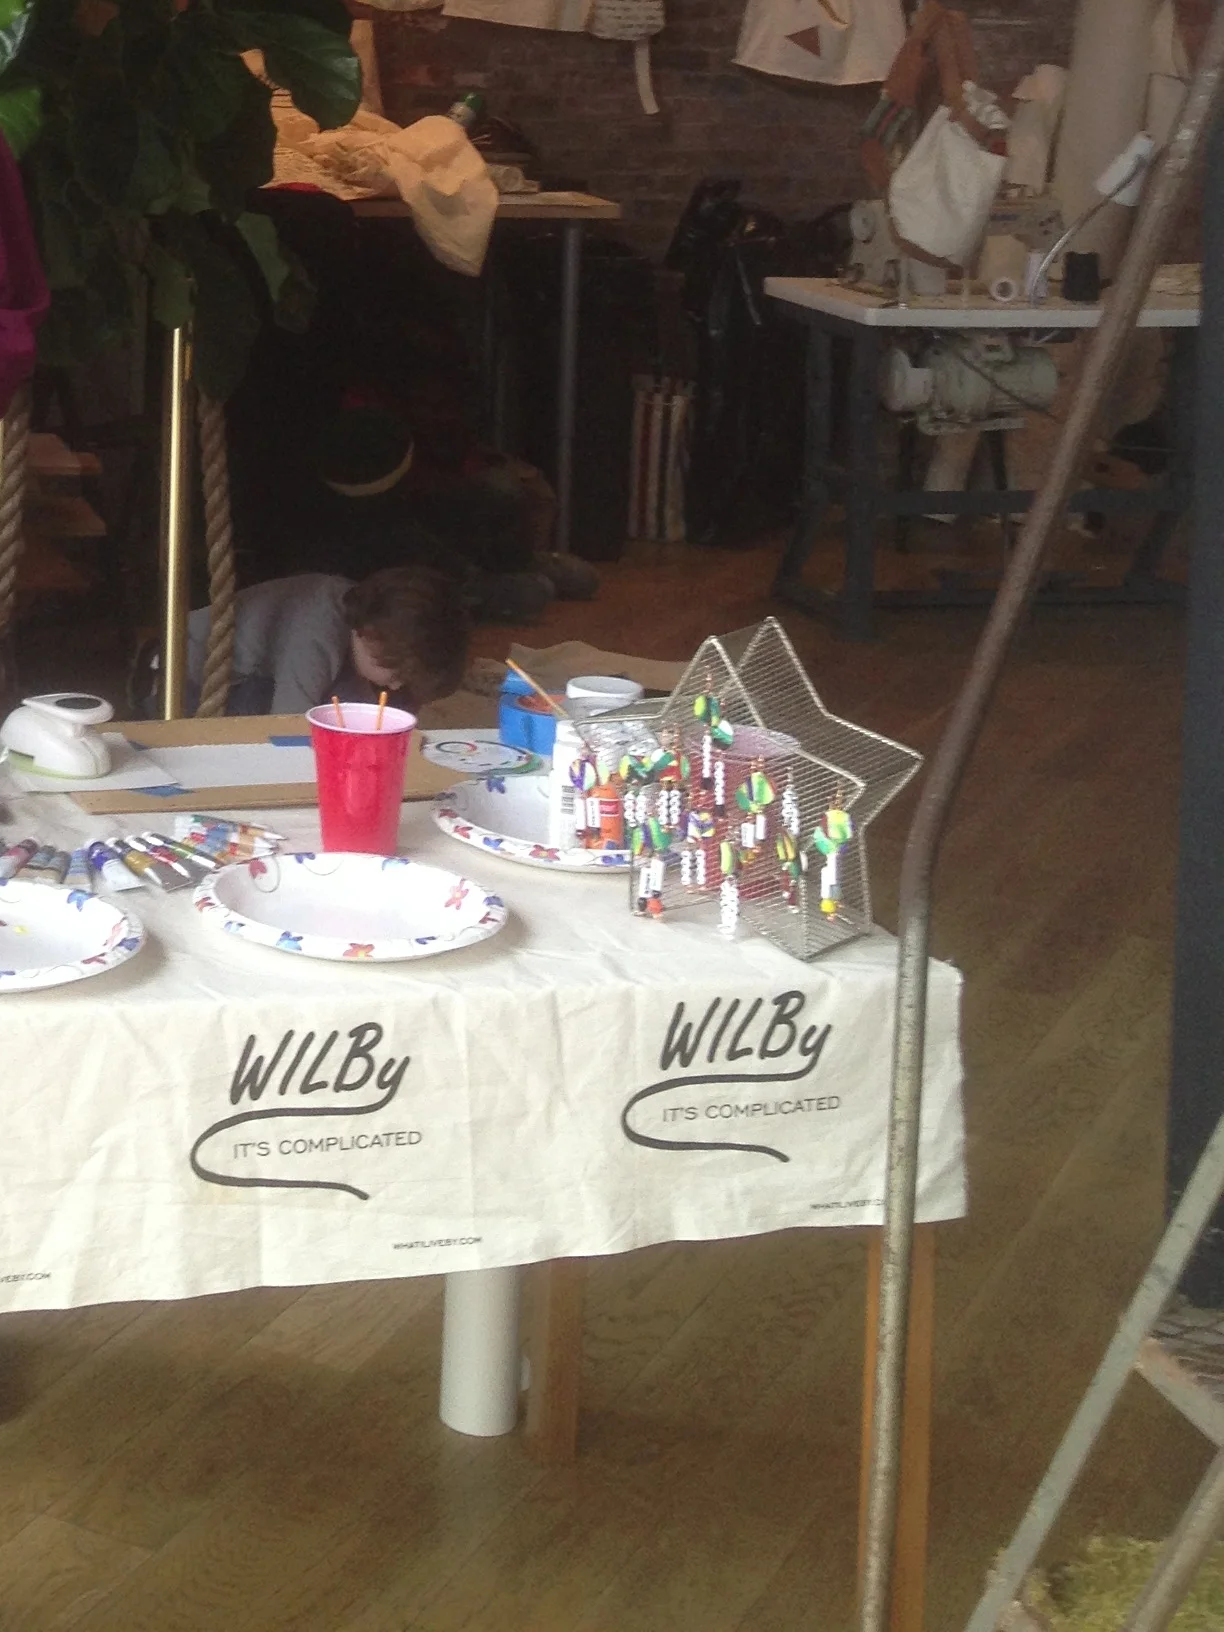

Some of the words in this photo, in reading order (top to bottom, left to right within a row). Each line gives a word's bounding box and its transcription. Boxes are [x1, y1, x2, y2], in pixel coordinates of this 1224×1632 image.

[659, 990, 831, 1074] WILBy
[229, 1021, 410, 1110] WILBy
[663, 1106, 698, 1123] IT'S
[705, 1095, 840, 1120] COMPLICATED
[233, 1141, 271, 1160] IT'S
[278, 1131, 422, 1155] COMPLICATED
